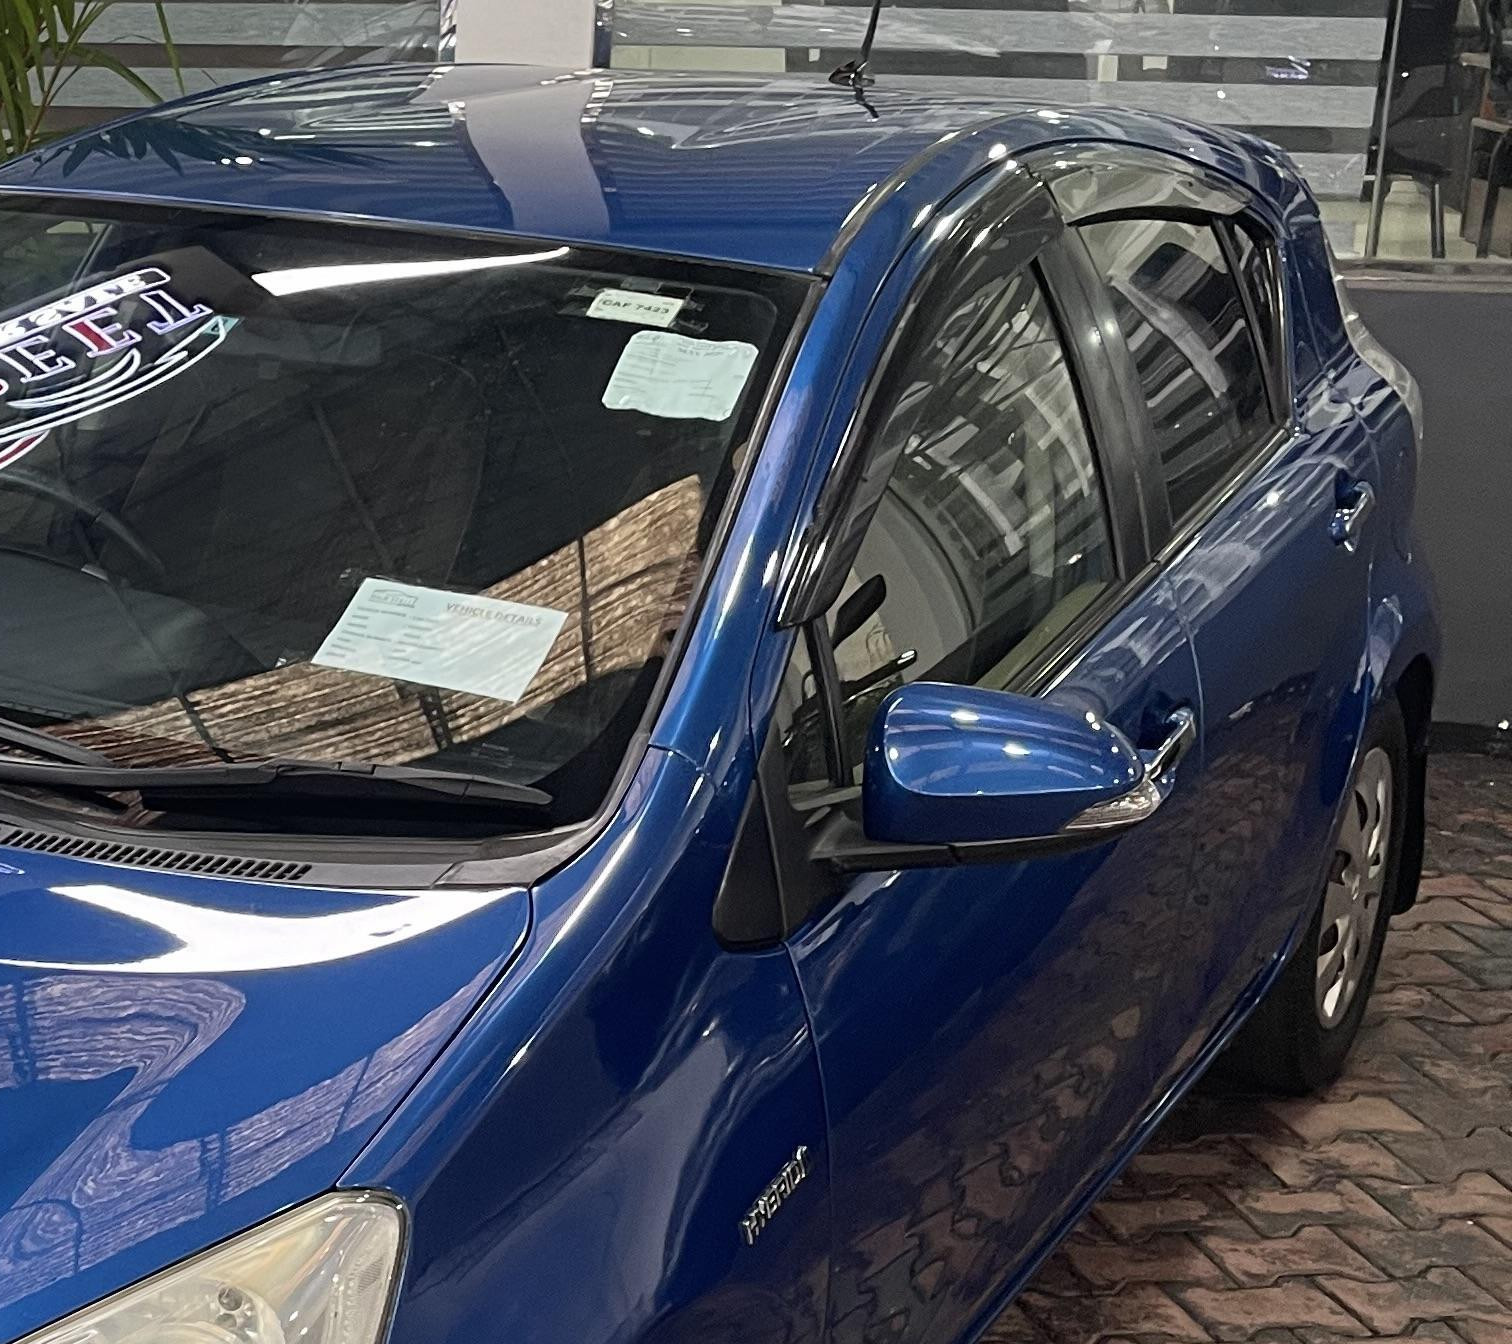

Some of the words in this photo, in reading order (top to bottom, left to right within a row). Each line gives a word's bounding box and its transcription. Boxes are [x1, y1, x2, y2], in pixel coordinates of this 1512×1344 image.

[446, 602, 493, 620] VEHICLE
[495, 611, 542, 626] DETAILS
[741, 1145, 808, 1246] HYBRID
